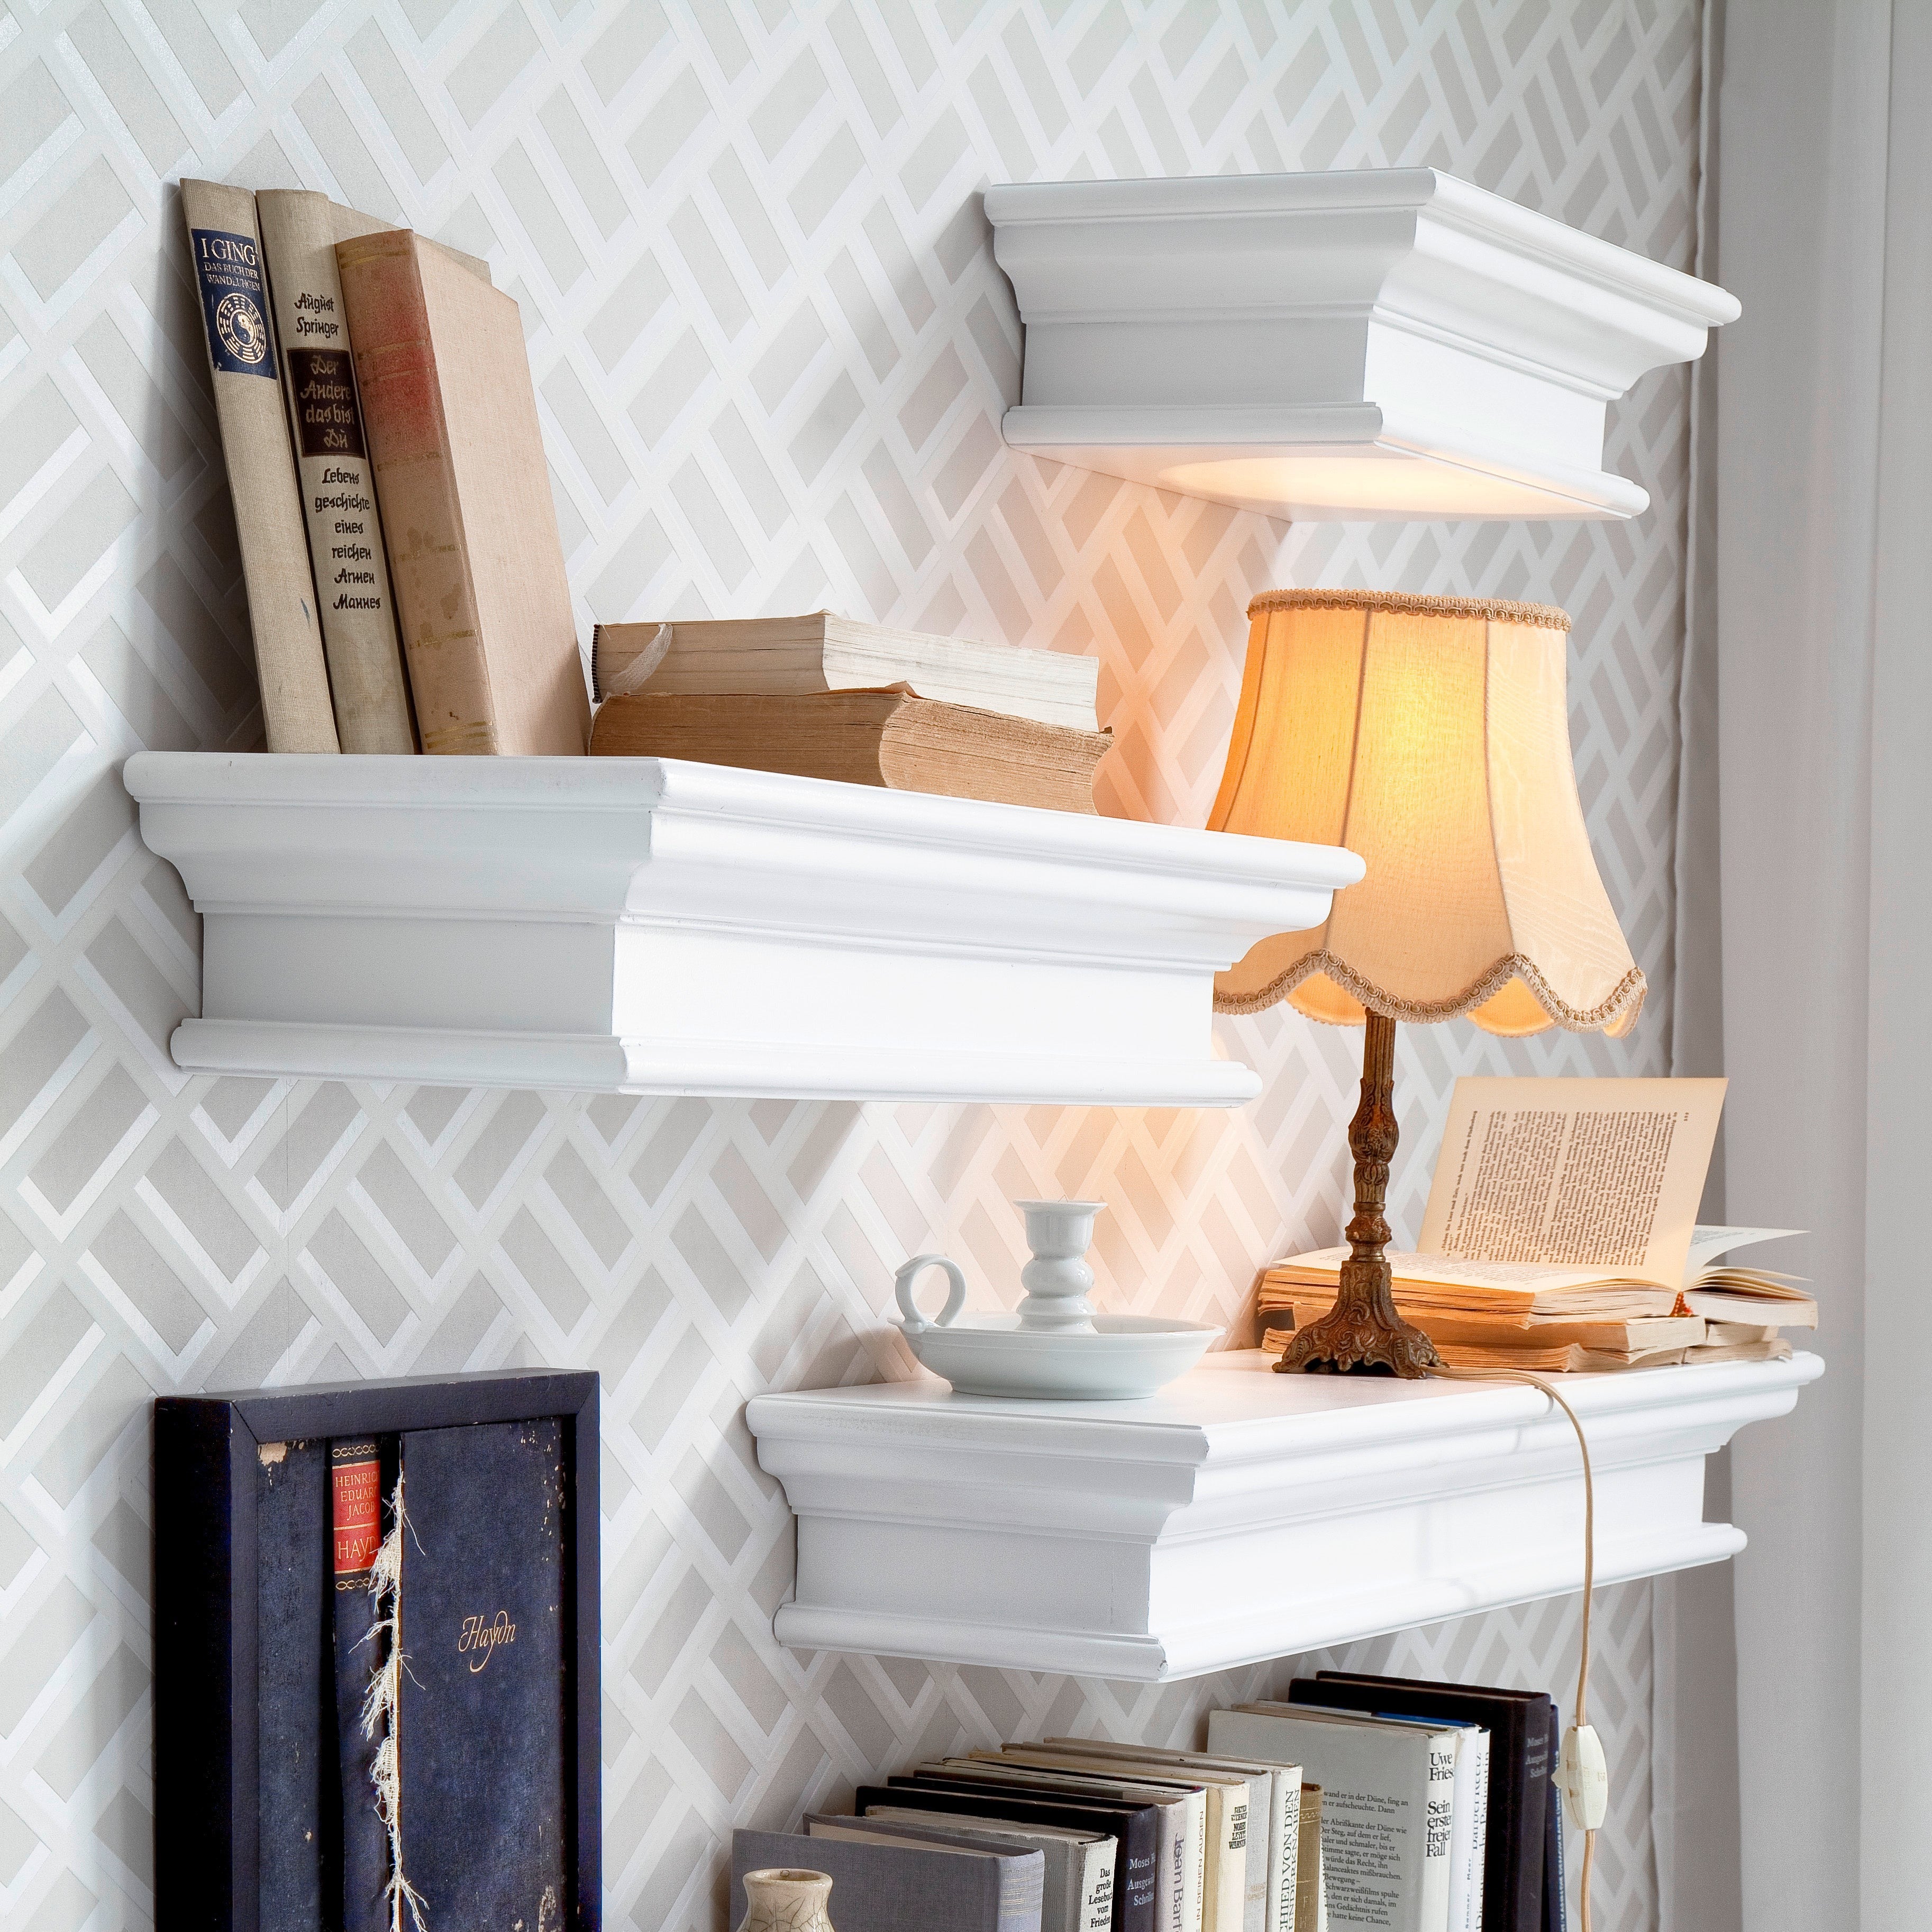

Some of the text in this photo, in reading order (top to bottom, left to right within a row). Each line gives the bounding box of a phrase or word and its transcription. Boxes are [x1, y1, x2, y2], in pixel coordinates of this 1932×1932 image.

[201, 239, 256, 265] I GING
[204, 262, 258, 279] DAS BUCH DER
[206, 274, 260, 291] WANDLUNGEN
[294, 293, 334, 313] August
[296, 316, 339, 338] Springer
[311, 355, 339, 375] Der
[300, 380, 351, 400] Andere
[306, 404, 354, 425] das bist
[322, 468, 359, 485] Lebens
[315, 493, 370, 513] geschichte
[334, 520, 363, 534] eines
[332, 544, 371, 561] reichen
[334, 568, 375, 584] Armen
[333, 594, 381, 609] Mannes
[335, 1471, 378, 1487] HEINRIC
[347, 1501, 375, 1521] JACOB
[458, 1610, 516, 1672] Haydn
[1430, 1753, 1452, 1766] Uwe
[1367, 1794, 1386, 1804] Düne,
[1388, 1797, 1399, 1807] fing
[1428, 1800, 1450, 1815] Sein
[1284, 1790, 1293, 1829] DEN
[1330, 1818, 1364, 1829] Abrißkante
[1332, 1828, 1345, 1837] Steg,
[1380, 1833, 1391, 1842] lief,
[1350, 1840, 1377, 1850] schmaler,
[1426, 1842, 1445, 1857] Fall
[1282, 1834, 1291, 1876] VON
[1129, 1857, 1150, 1870] Moses
[1357, 1859, 1376, 1867] Recht,
[1100, 1868, 1110, 1878] Das
[1360, 1869, 1402, 1880] mißbrauchen.
[1096, 1880, 1111, 1894] große
[1097, 1905, 1108, 1914] vom
[1337, 1903, 1370, 1913] Gedächtnis
[1364, 1897, 1387, 1907] damals,
[1197, 1909, 1200, 1920] IN
[1333, 1911, 1347, 1919] hatte
[1366, 1916, 1391, 1926] Chance,
